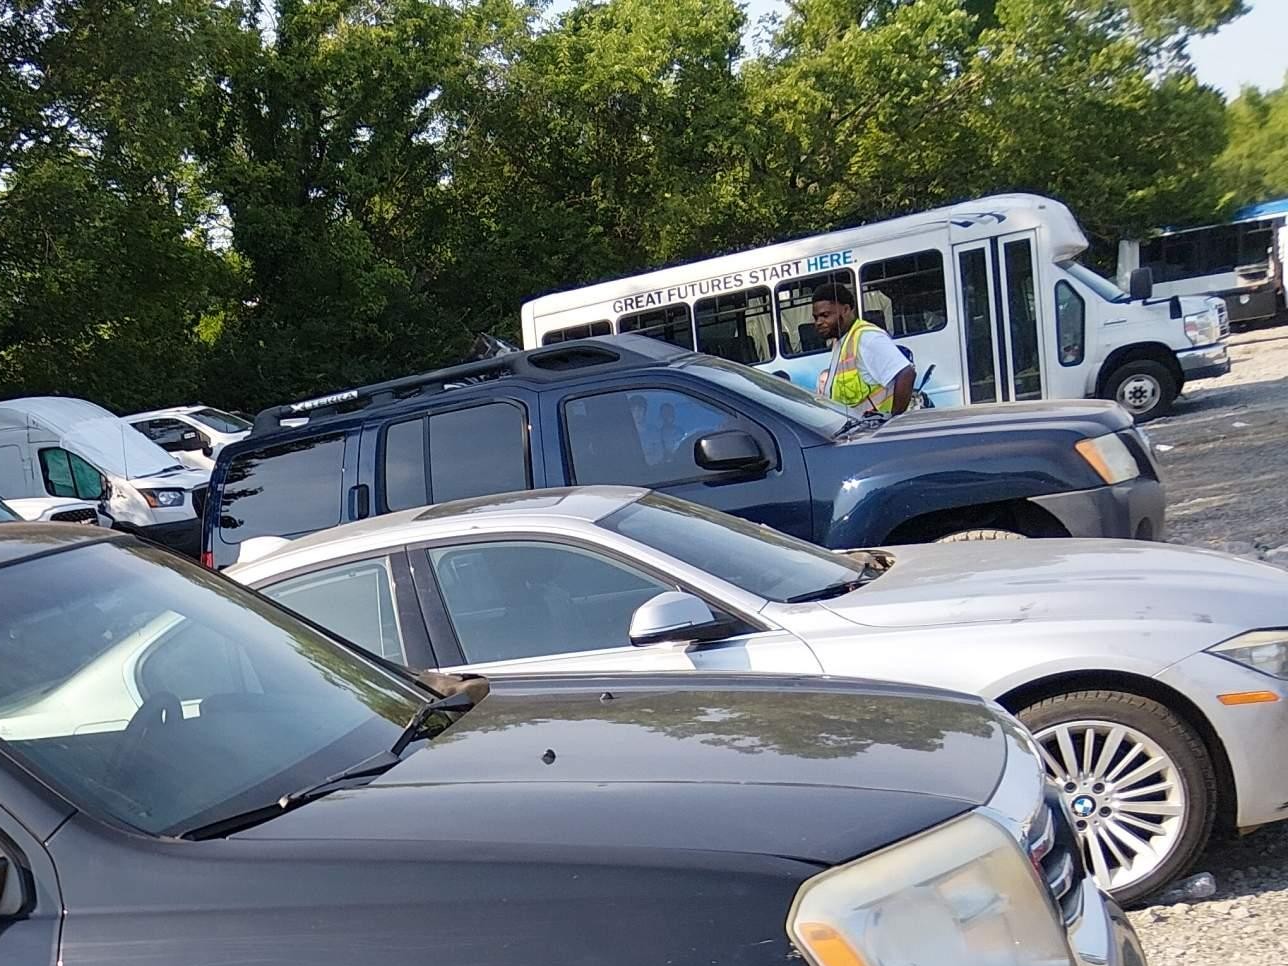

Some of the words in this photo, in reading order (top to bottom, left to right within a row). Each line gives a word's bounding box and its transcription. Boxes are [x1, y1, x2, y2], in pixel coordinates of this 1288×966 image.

[612, 291, 664, 314] GREAT
[666, 273, 744, 302] FUTURES
[748, 260, 803, 285] START
[806, 249, 858, 273] HERE.
